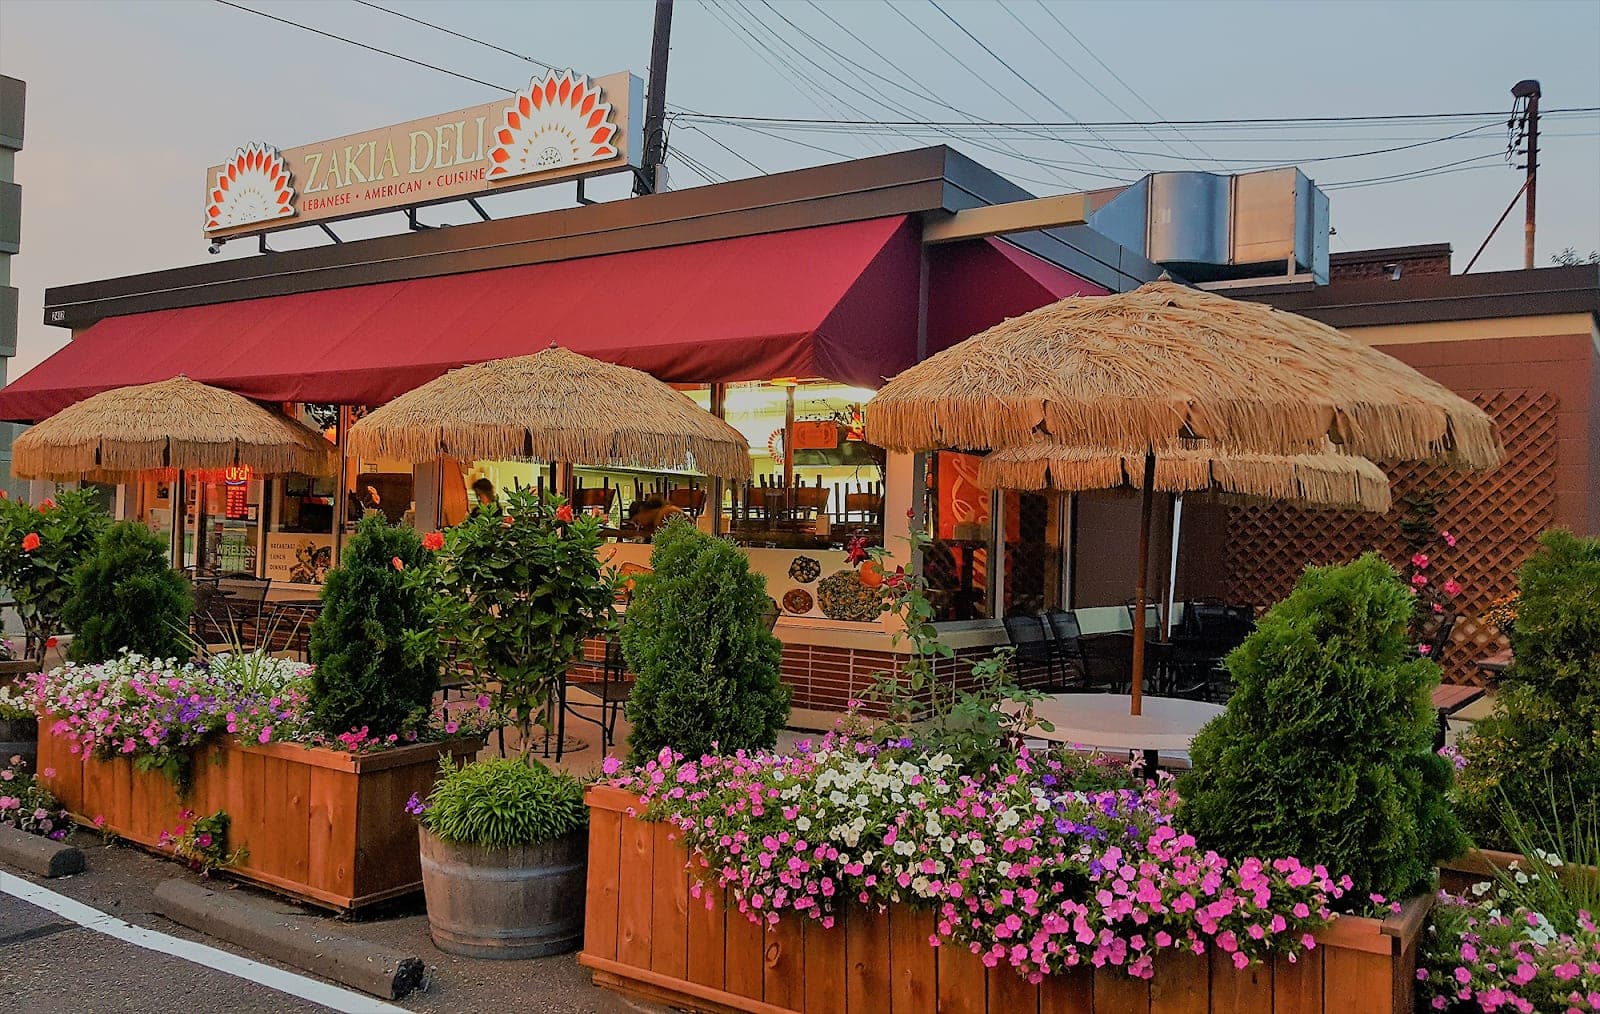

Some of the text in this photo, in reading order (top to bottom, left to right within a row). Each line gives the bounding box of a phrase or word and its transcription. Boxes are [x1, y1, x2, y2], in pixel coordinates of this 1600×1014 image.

[303, 116, 487, 194] ZAKIA DELI
[302, 168, 485, 211] LEBANESE AMERICAN CUISINE
[216, 543, 256, 557] WIRELESS
[217, 555, 255, 569] INNET
